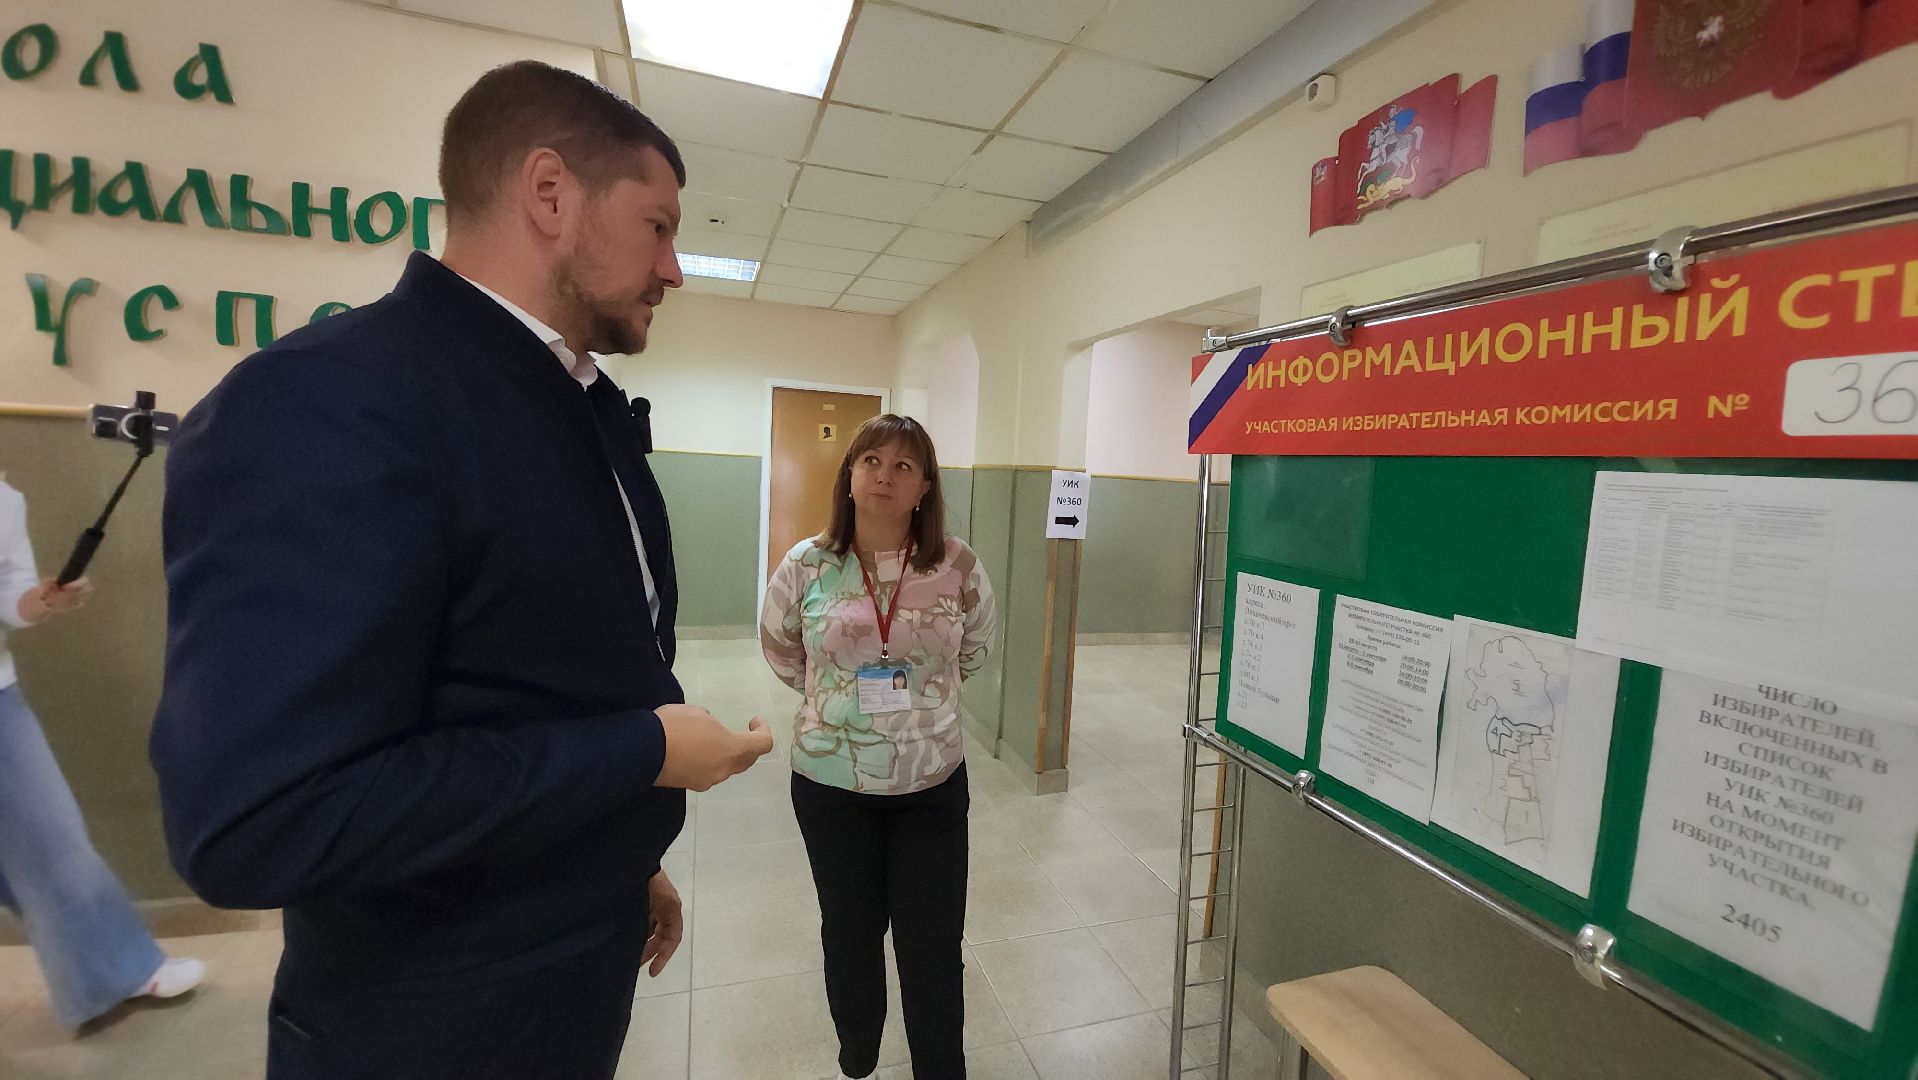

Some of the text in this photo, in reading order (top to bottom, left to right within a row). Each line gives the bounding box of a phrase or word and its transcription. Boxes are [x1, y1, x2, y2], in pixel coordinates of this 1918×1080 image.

[1246, 274, 1749, 391] ИНФОРМАЦИОННЫЙ
[1245, 393, 1750, 434] УЧАСТКОВАЯ ИЗБИРАТЕЛЬНАЯ КОМИССИЯ №
[1056, 496, 1082, 506] №360
[1062, 479, 1080, 488] УИК
[1247, 582, 1292, 603] УИК №360
[1757, 684, 1838, 716] ЧИСЛО
[1698, 710, 1888, 775] ВКЛЮЧЕННЫХ В
[1738, 742, 1835, 782] СПИСОК
[1704, 750, 1864, 814] ИЗБИРАТЕЛЕЙ
[1725, 778, 1835, 825] УИК №360
[1706, 792, 1847, 851] НА МОМЕНТ
[1709, 814, 1832, 870] ОТКРЫТИЯ
[1672, 818, 1870, 907] ИЗБИРАТЕЛЬНОГО
[1720, 903, 1782, 944] 2405
